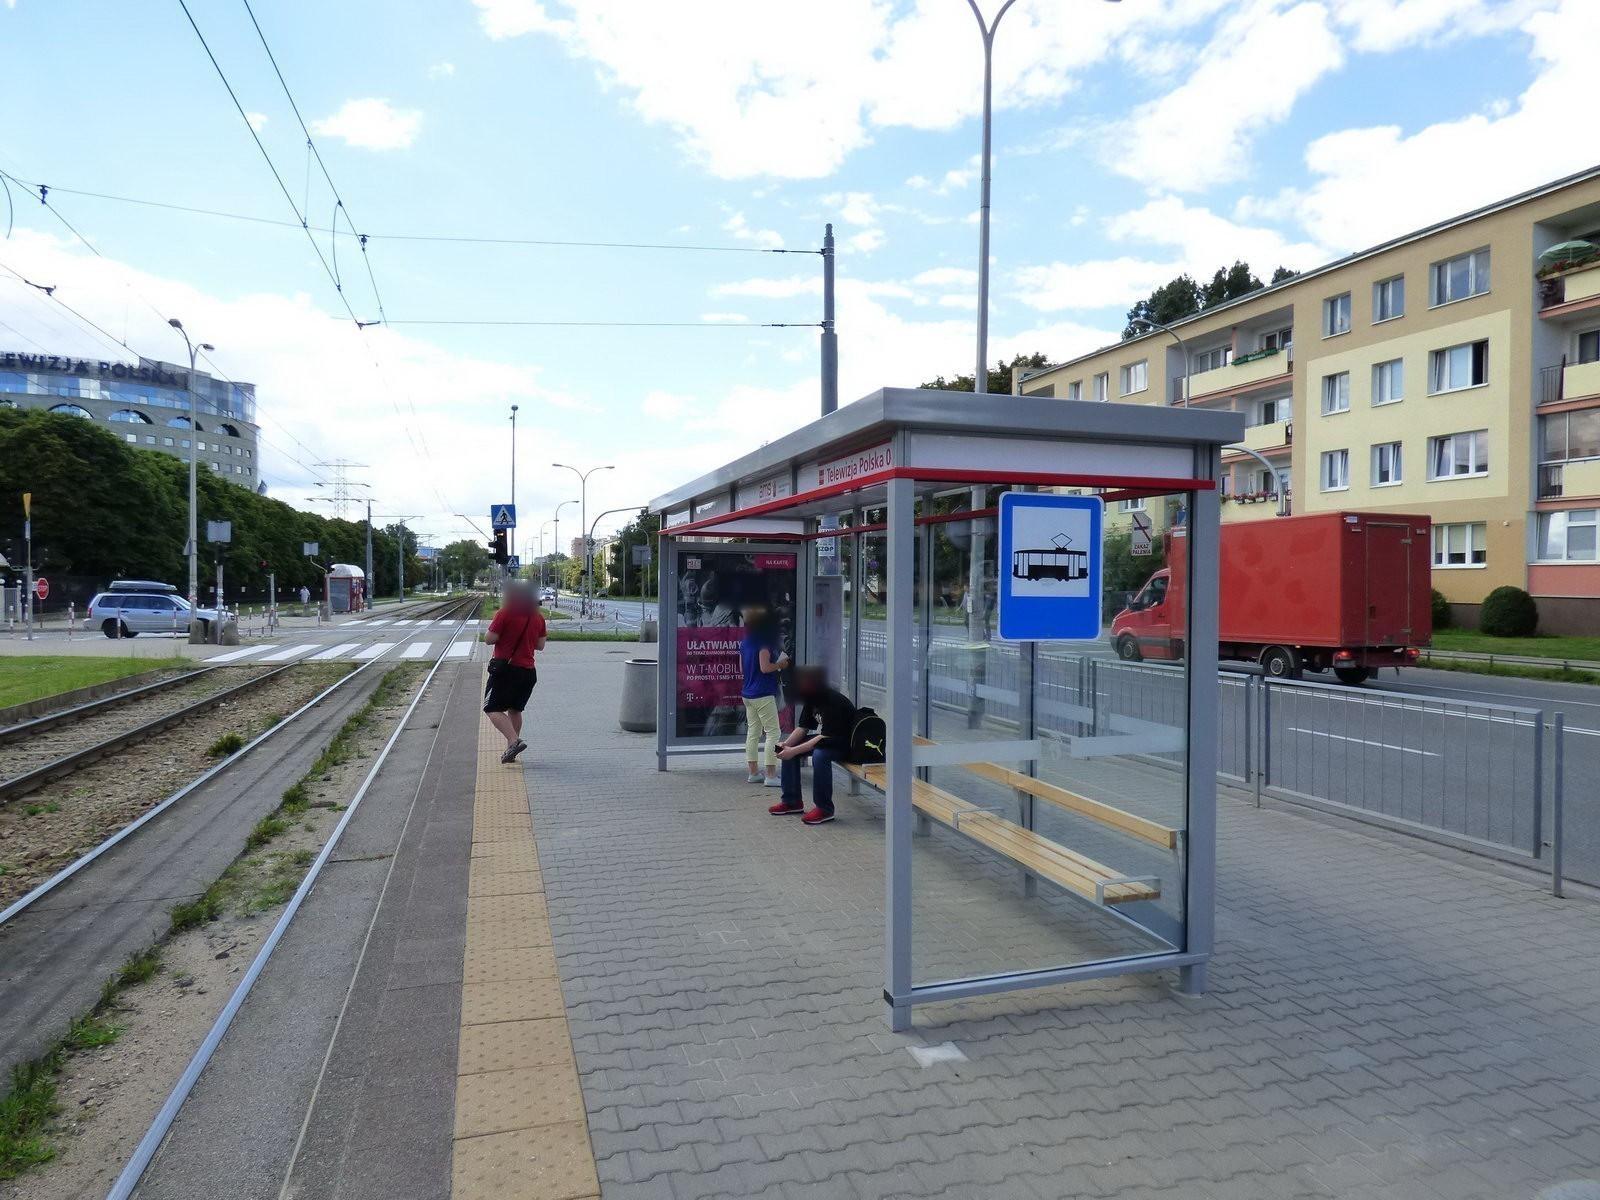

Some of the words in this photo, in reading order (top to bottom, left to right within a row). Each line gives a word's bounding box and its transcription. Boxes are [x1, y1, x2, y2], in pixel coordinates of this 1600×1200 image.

[0, 352, 89, 375] EWIZJA
[99, 361, 178, 385] POLSKA
[826, 463, 858, 481] Telewizja
[859, 452, 884, 474] Polska
[686, 640, 743, 650] UŁATWIAMY
[686, 664, 697, 674] W
[699, 664, 741, 674] T-MOBIL
